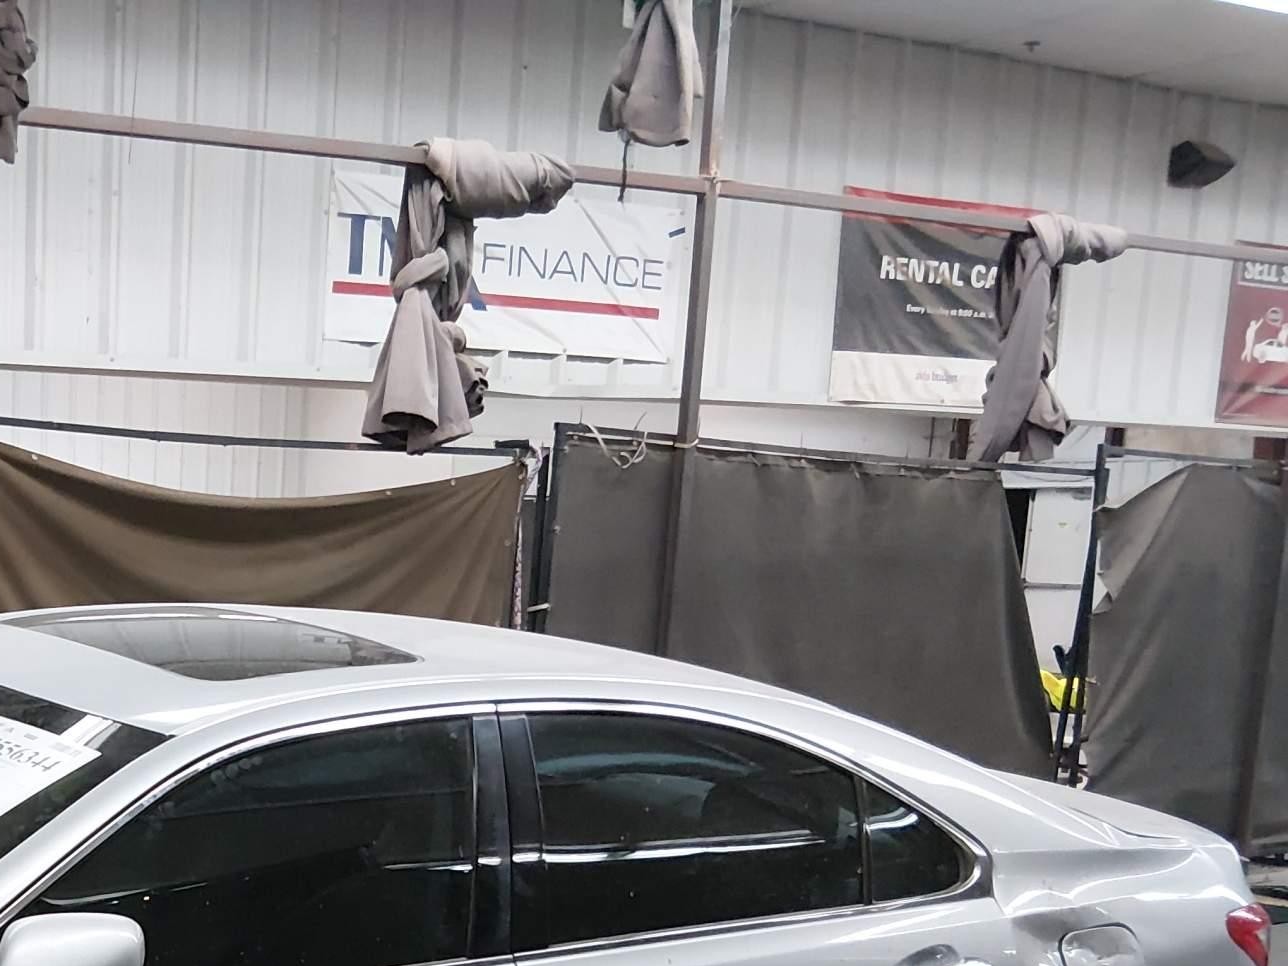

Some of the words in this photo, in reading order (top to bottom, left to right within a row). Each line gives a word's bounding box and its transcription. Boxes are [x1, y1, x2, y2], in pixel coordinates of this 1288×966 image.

[481, 242, 665, 291] FINANCE
[880, 254, 964, 288] RENTAL
[970, 264, 999, 289] CA
[1244, 261, 1279, 282] SELL
